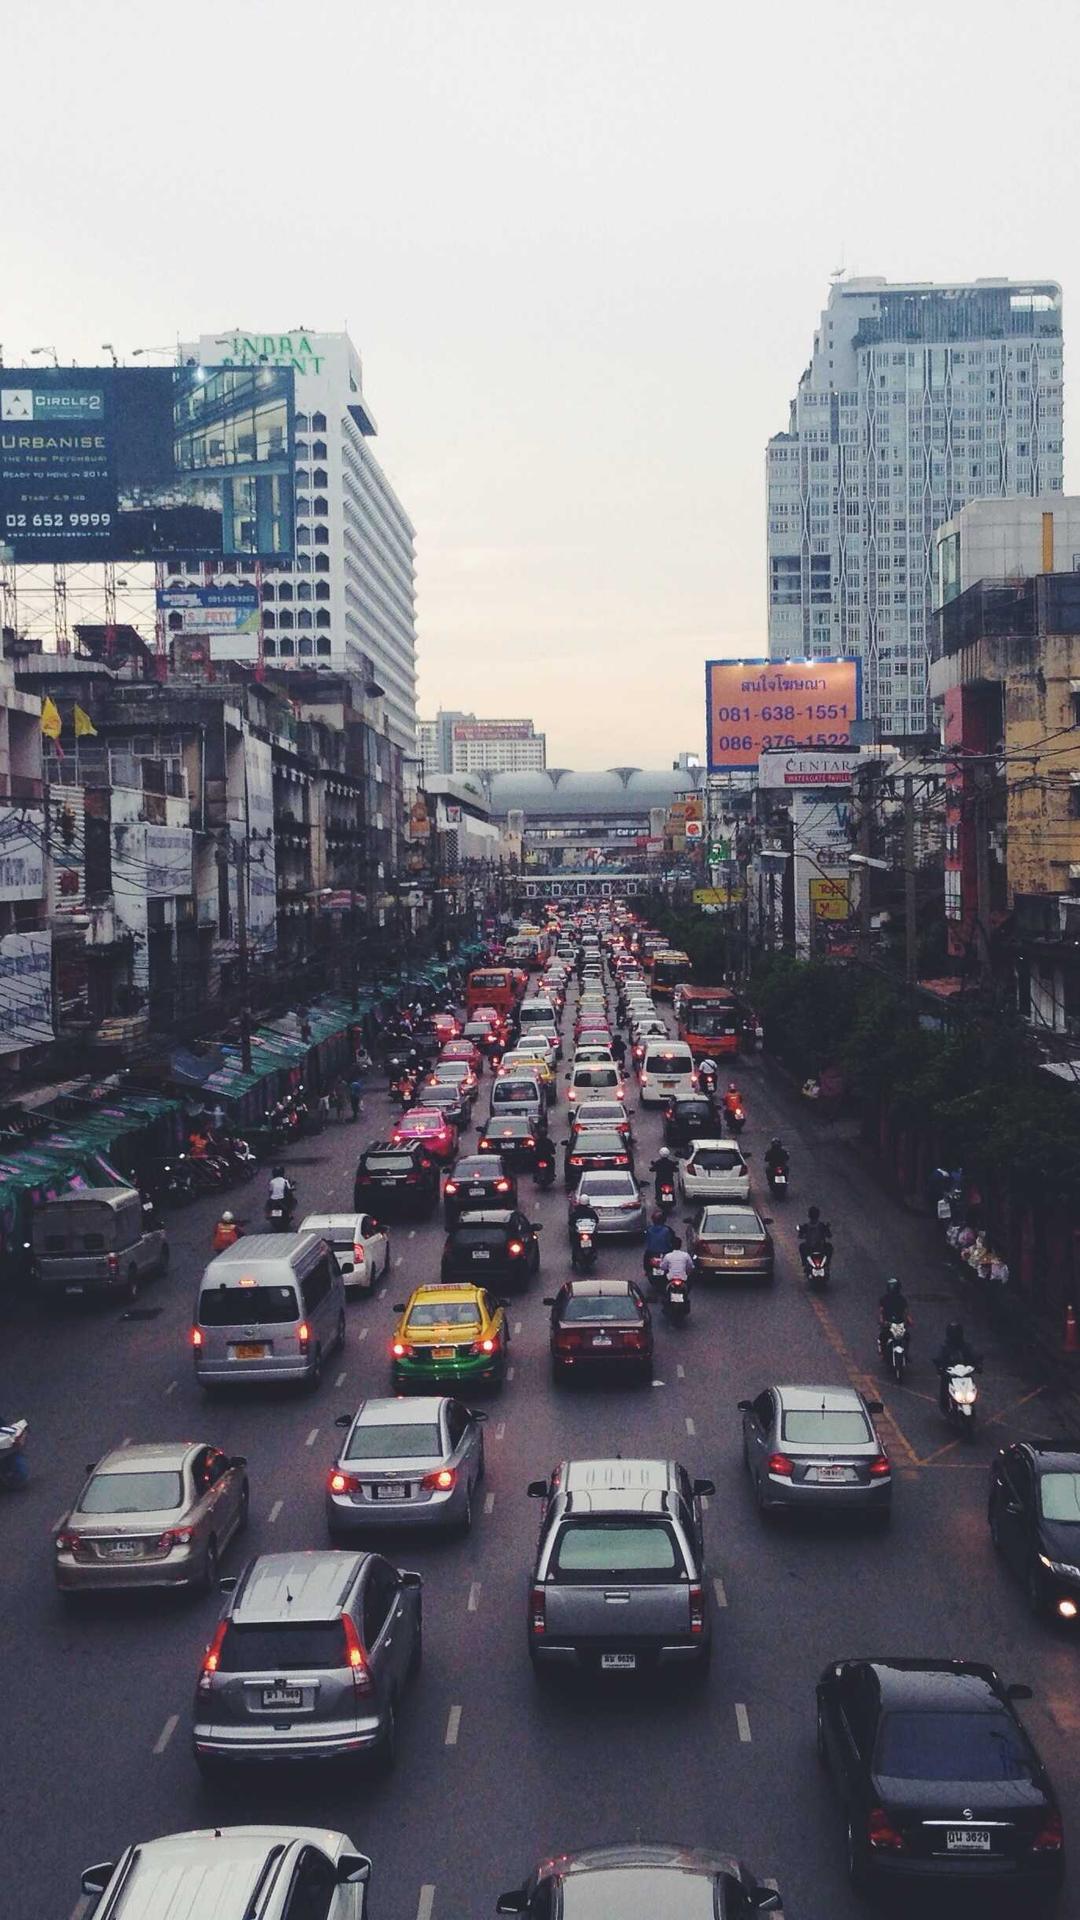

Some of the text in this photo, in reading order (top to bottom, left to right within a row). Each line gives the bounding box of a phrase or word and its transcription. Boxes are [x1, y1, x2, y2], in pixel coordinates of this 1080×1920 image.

[232, 336, 313, 355] INDRA
[2, 435, 106, 449] URBANISE
[6, 514, 110, 527] 02 652 9999
[719, 704, 849, 722] 081-638-1551
[719, 733, 850, 750] 086-376-1522
